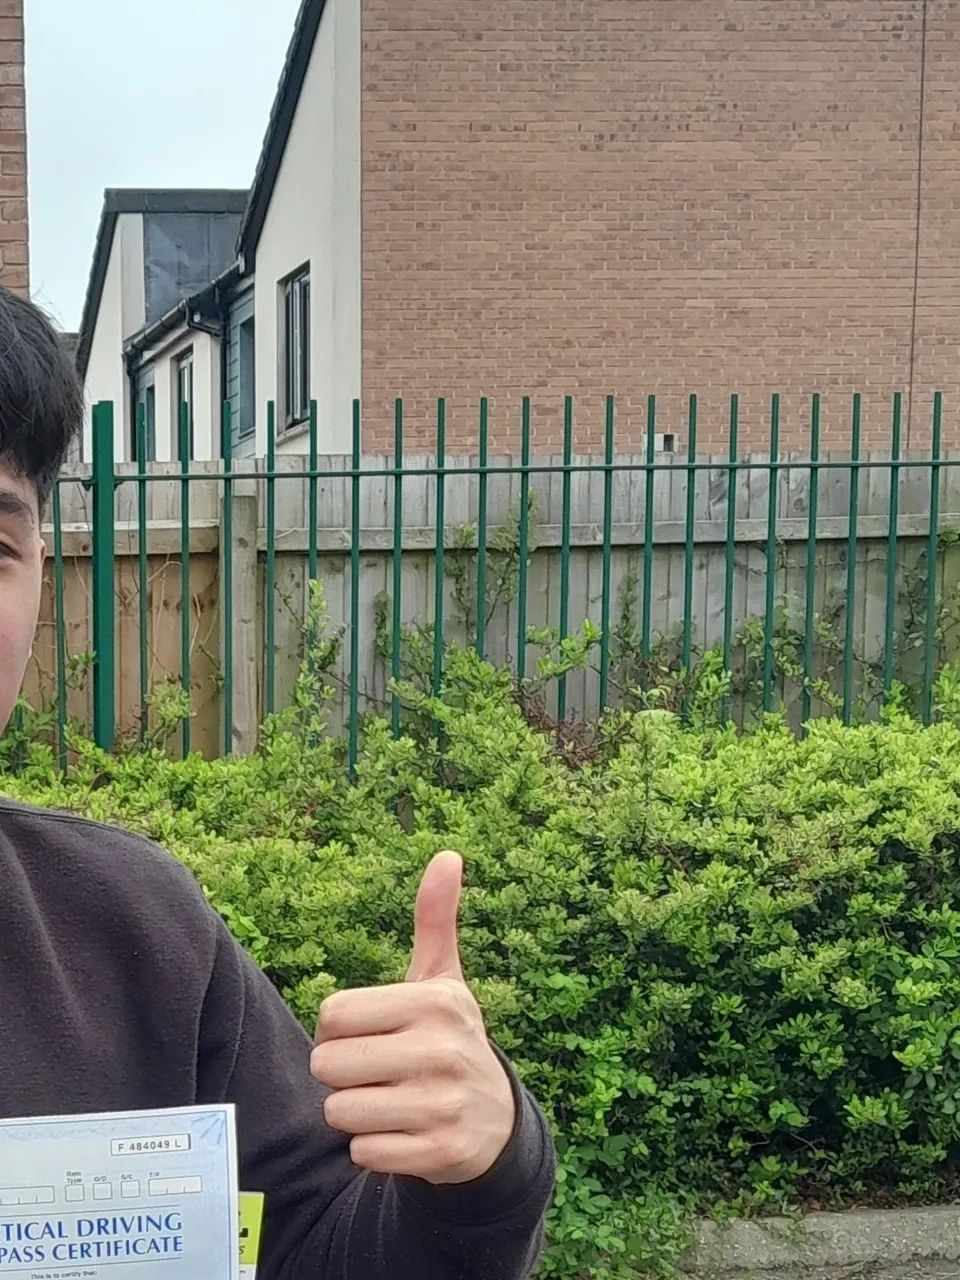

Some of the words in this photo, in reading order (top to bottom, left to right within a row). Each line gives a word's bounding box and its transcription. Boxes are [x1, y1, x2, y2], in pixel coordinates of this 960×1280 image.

[118, 1144, 124, 1152] F
[130, 1140, 170, 1150] 484049
[175, 1140, 181, 1148] L
[77, 1212, 182, 1237] DRIVING
[52, 1236, 183, 1260] CERTIFICATE
